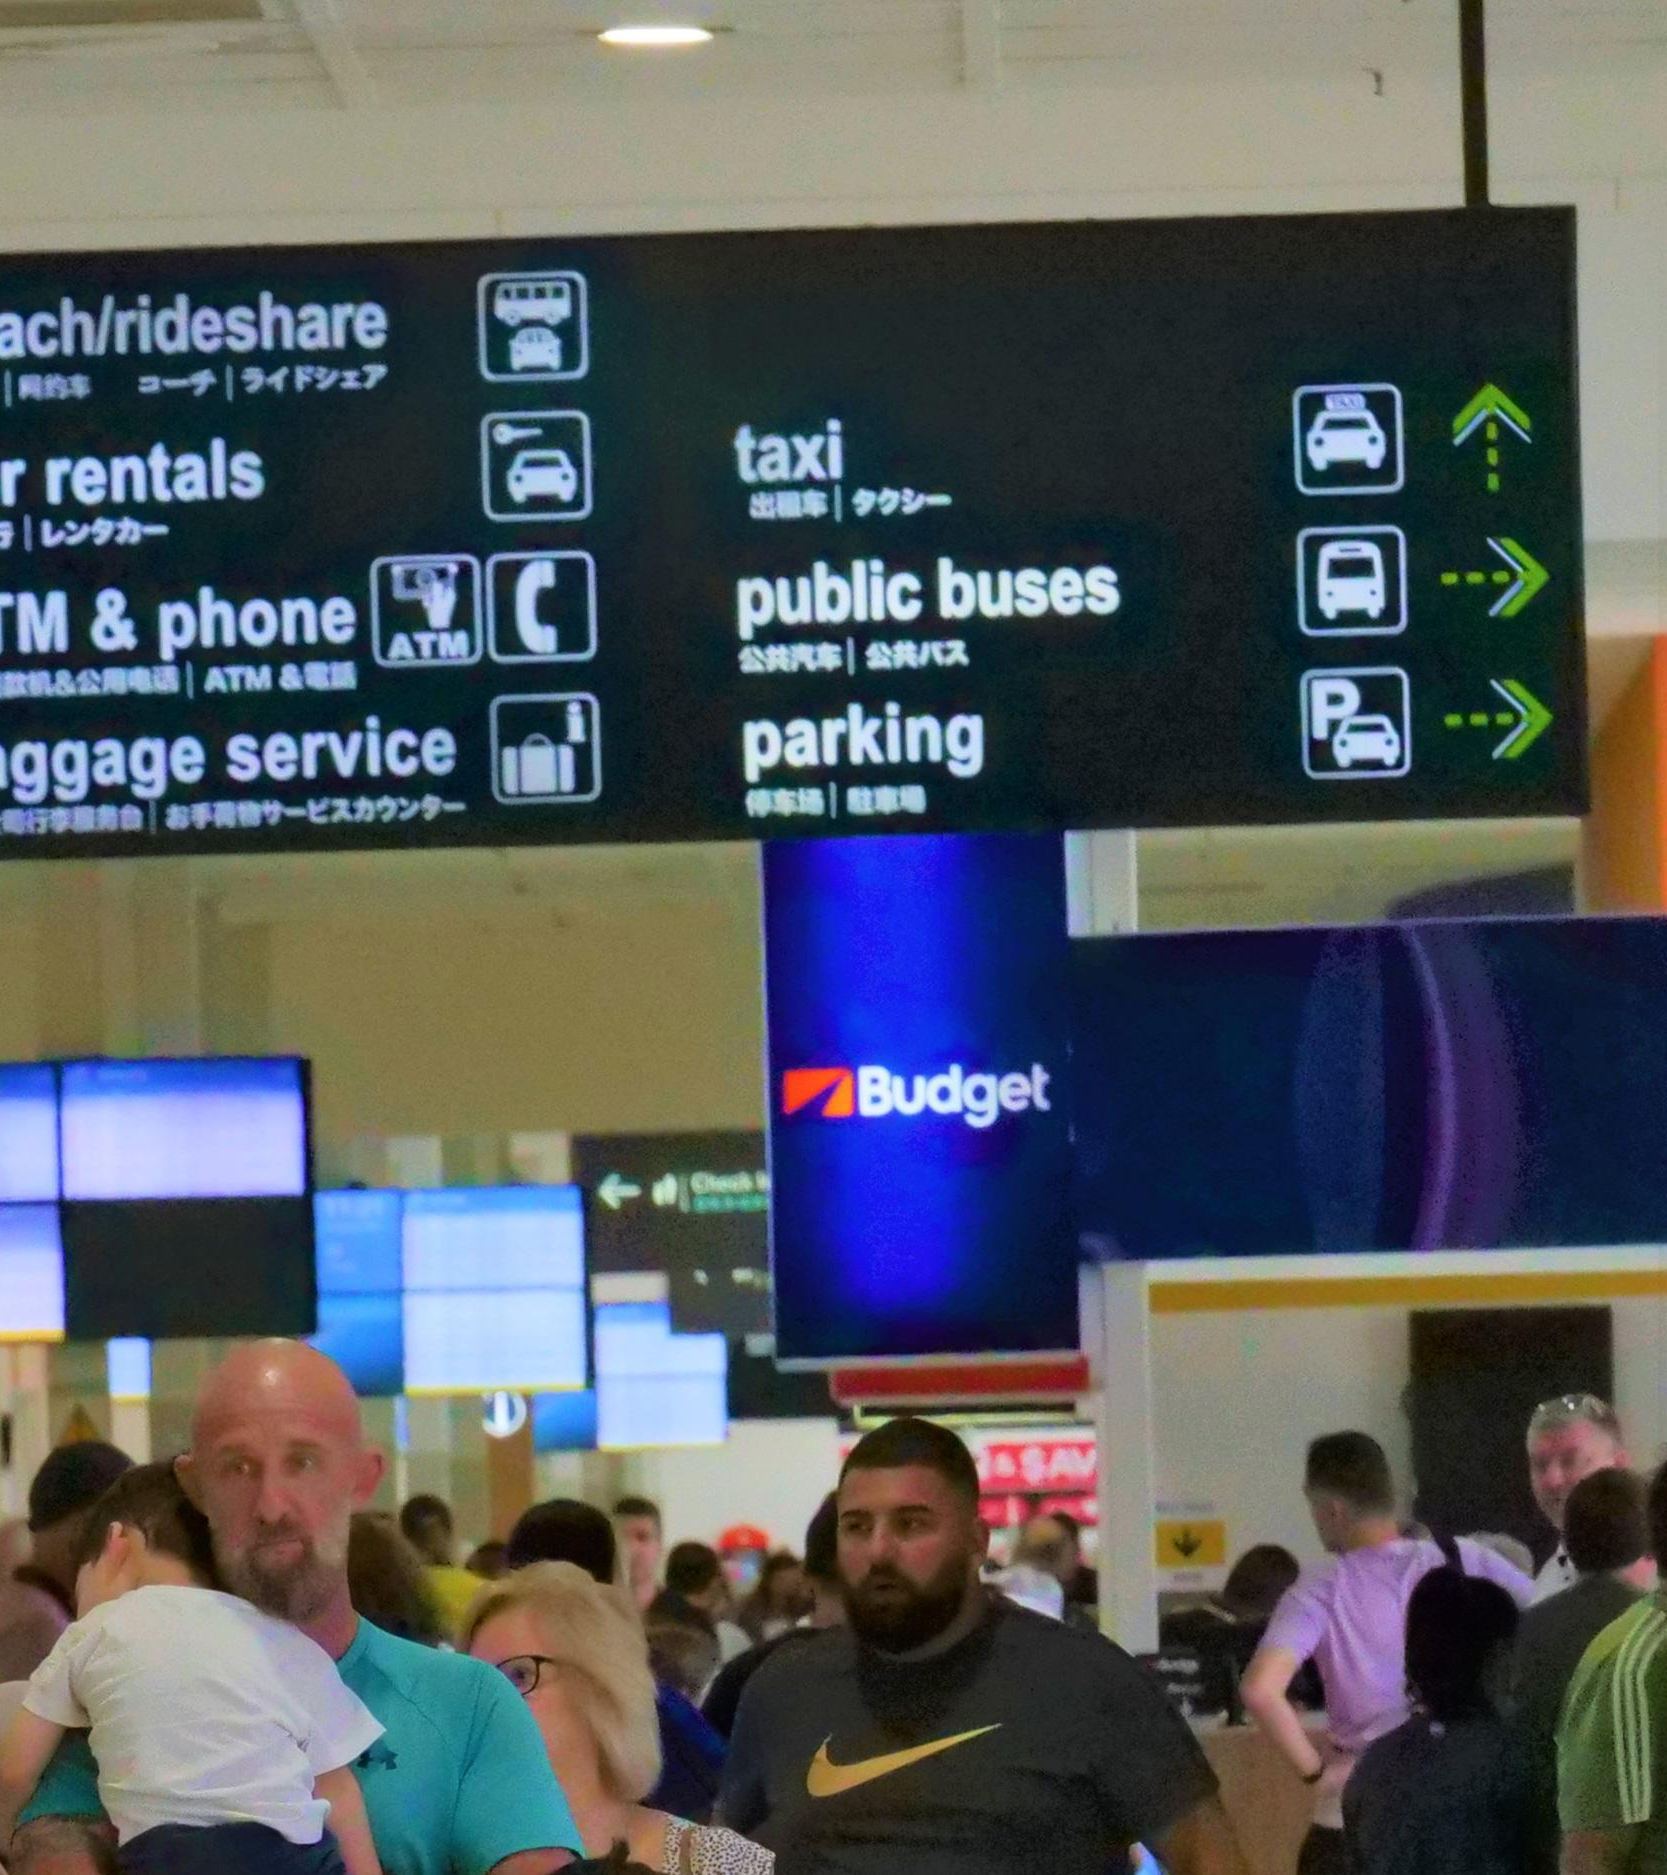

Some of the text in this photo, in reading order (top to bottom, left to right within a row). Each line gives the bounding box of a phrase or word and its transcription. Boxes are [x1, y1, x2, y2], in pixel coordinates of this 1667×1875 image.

[45, 437, 266, 506] rentals
[734, 418, 844, 484] taxi
[40, 516, 170, 548] レンタカー
[91, 588, 139, 653] &
[157, 585, 357, 662] phone
[736, 555, 1121, 641] public buses
[387, 630, 470, 660] ATM
[226, 715, 457, 783] service
[742, 700, 985, 784] parking
[857, 1062, 1051, 1129] Budget
